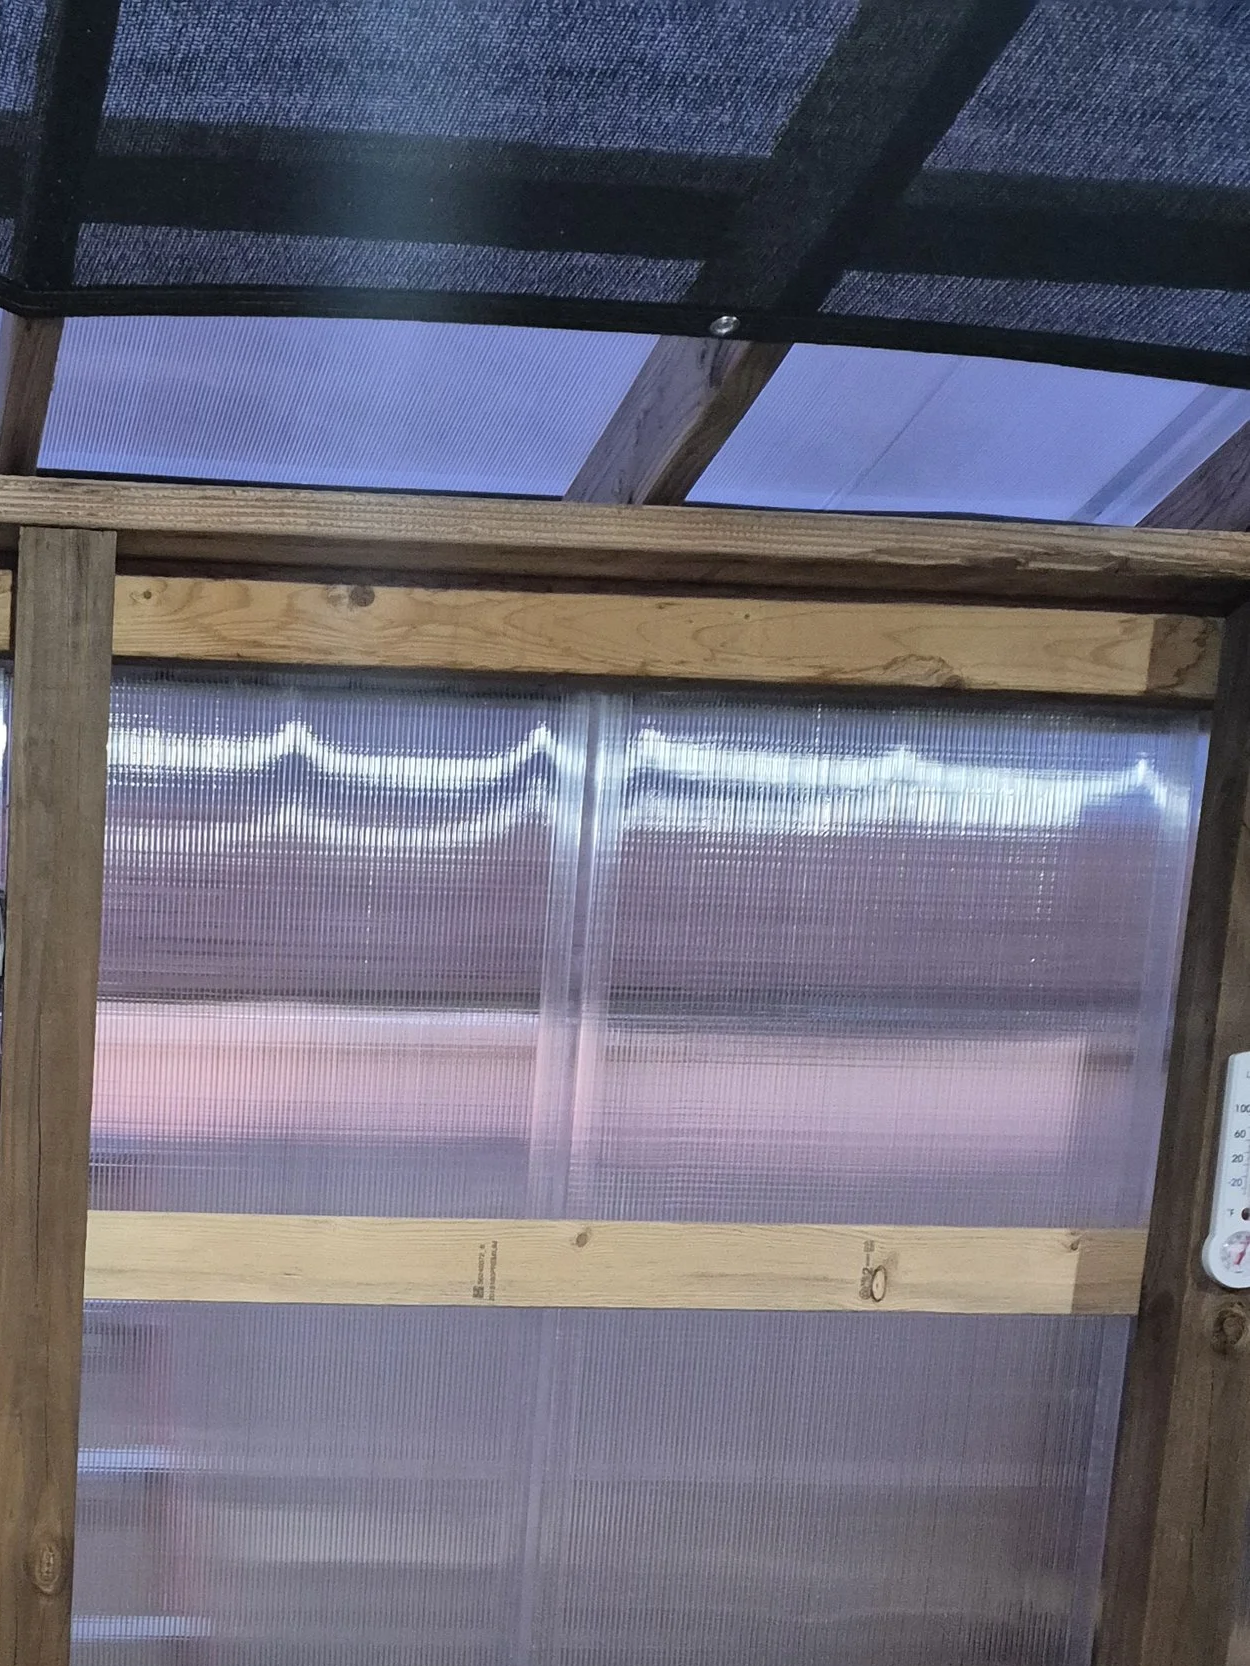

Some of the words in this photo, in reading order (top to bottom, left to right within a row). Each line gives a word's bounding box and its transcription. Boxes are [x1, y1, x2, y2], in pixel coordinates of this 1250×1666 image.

[1234, 1129, 1247, 1139] 60
[1232, 1154, 1244, 1164] 20
[1228, 1177, 1243, 1187] -20
